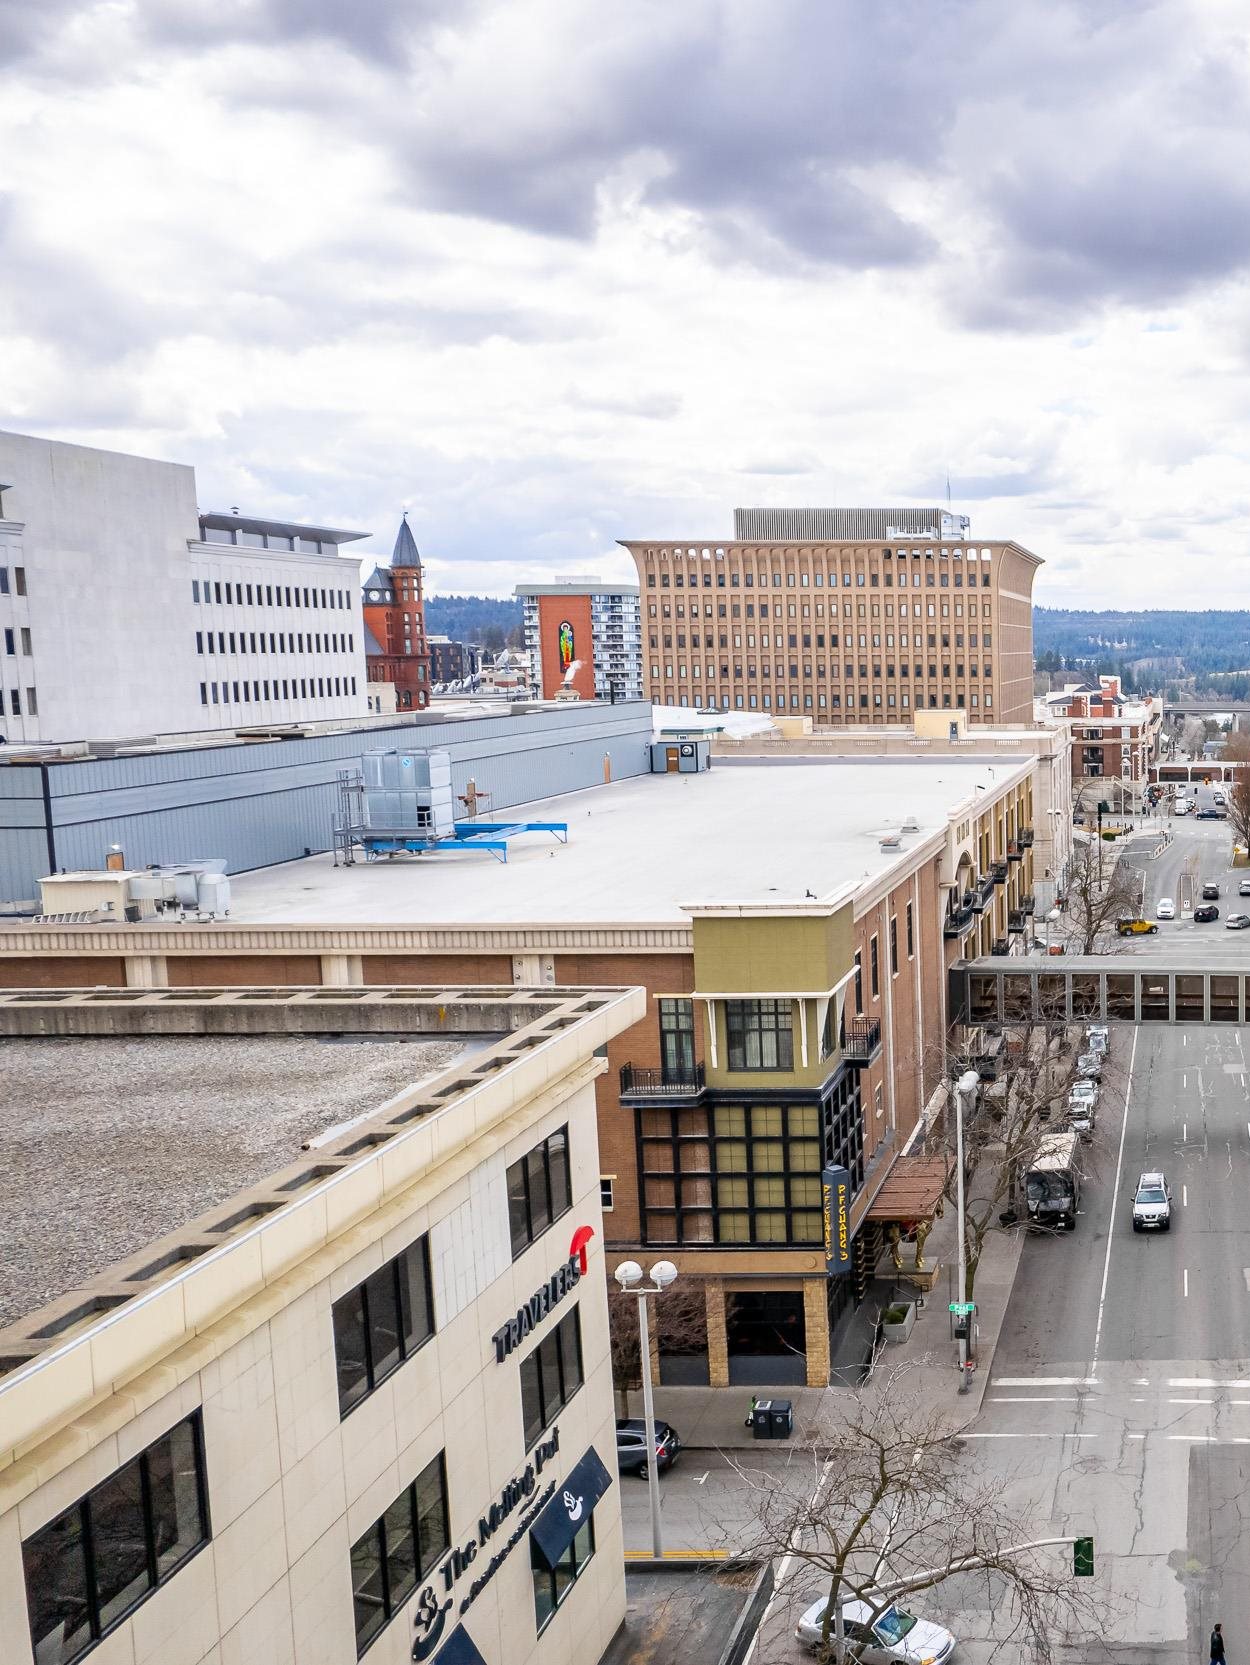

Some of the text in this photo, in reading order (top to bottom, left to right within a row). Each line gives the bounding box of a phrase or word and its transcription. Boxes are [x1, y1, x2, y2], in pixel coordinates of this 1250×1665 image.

[492, 1253, 581, 1363] TRAVELERS
[440, 1424, 560, 1592] The Melting Pot
